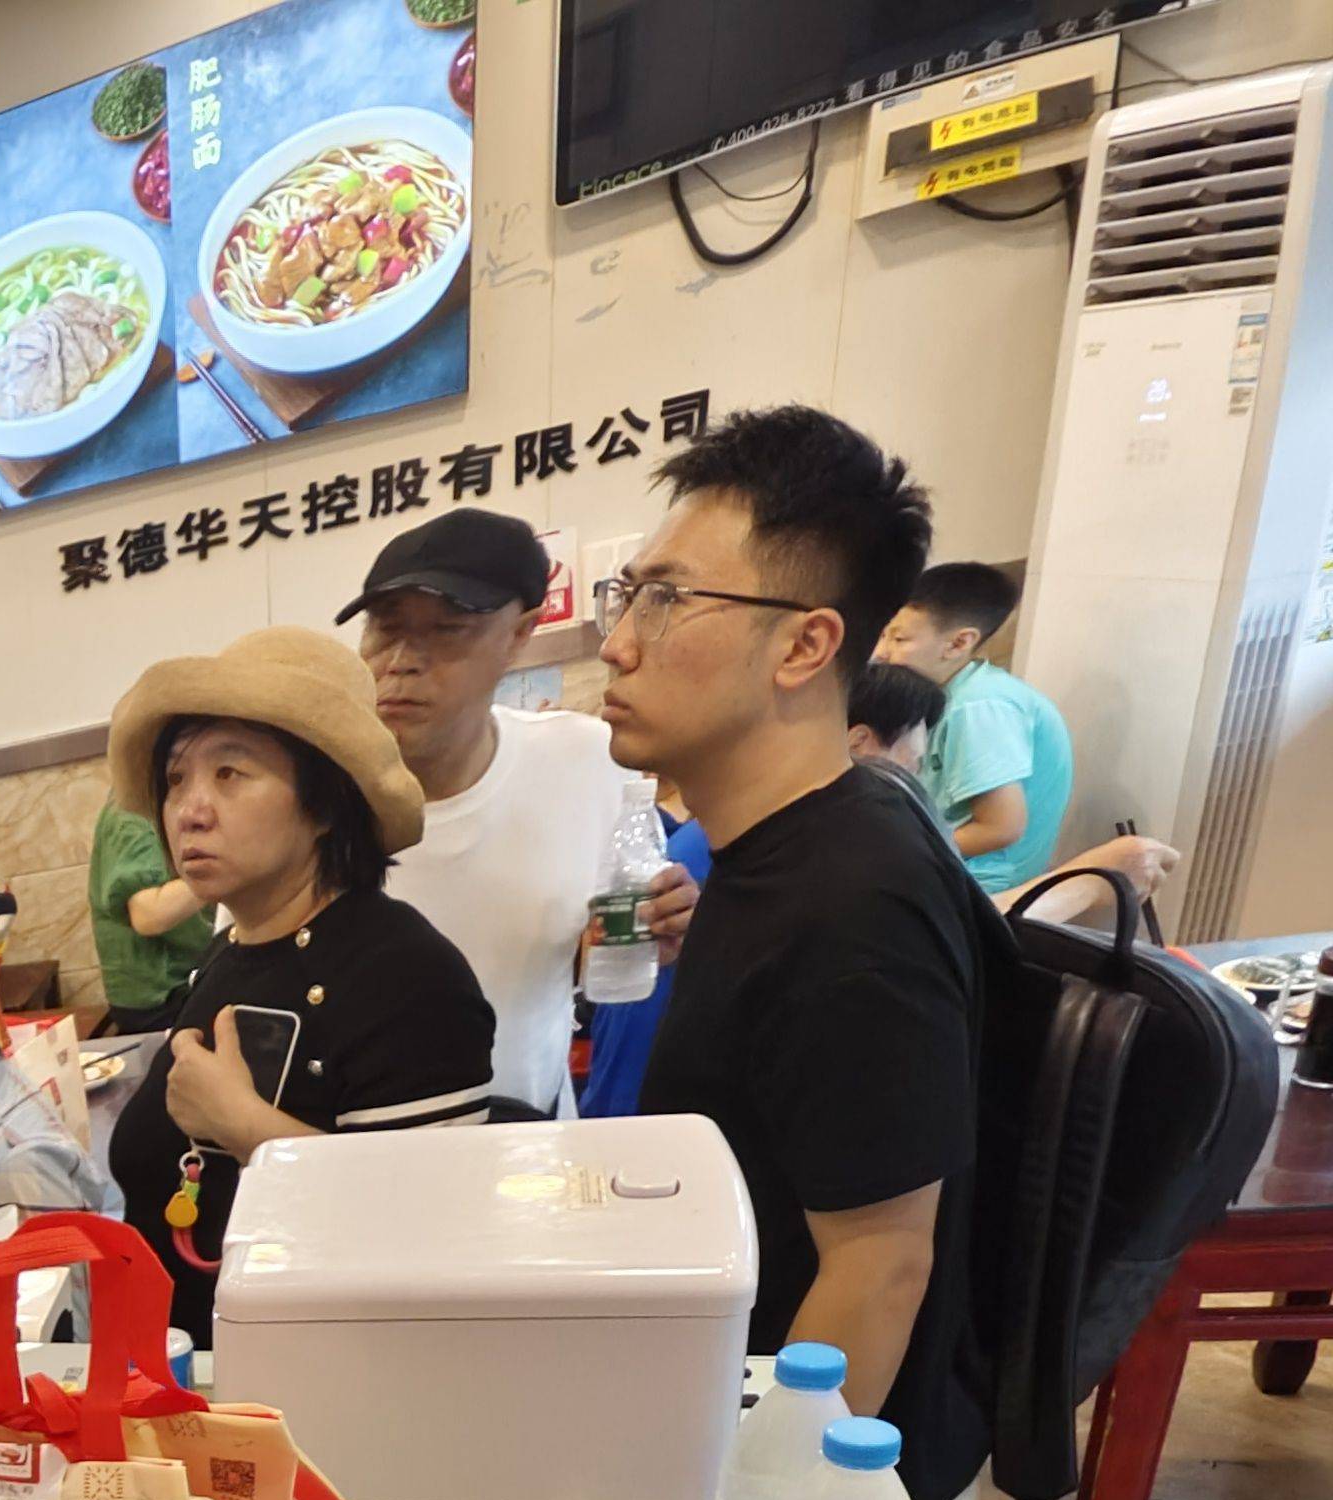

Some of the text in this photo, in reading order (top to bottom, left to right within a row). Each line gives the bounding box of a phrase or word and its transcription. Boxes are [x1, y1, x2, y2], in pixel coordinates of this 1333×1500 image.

[187, 57, 223, 171] 肥肠面
[57, 388, 713, 594] 聚德华天控股有限公司
